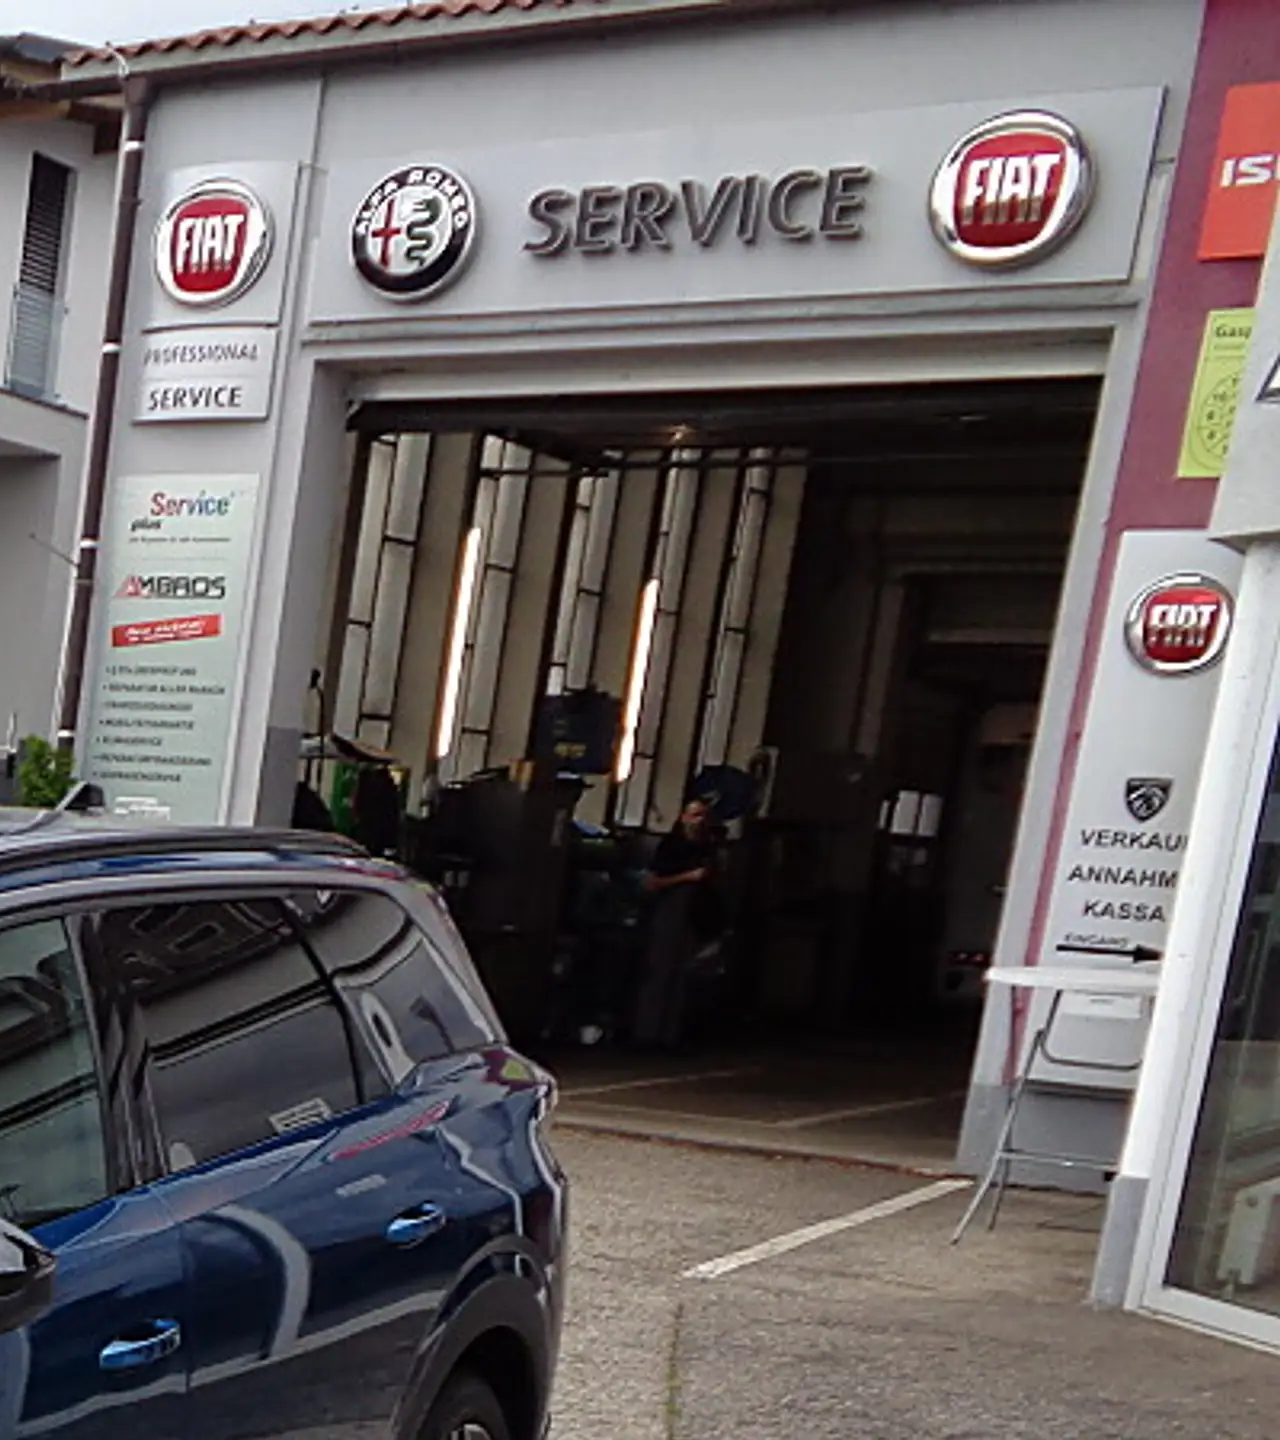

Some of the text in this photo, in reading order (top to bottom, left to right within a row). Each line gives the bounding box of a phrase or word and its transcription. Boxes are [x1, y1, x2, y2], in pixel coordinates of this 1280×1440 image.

[1220, 153, 1280, 189] IS
[965, 153, 1061, 224] FIAT
[516, 164, 874, 257] SERVICE
[176, 213, 244, 273] FIAT
[143, 343, 258, 366] PROFESSIONAL
[148, 385, 243, 411] SERVICE
[150, 489, 230, 516] Service
[1068, 864, 1178, 888] ANNAHM
[1083, 899, 1165, 922] KASSA
